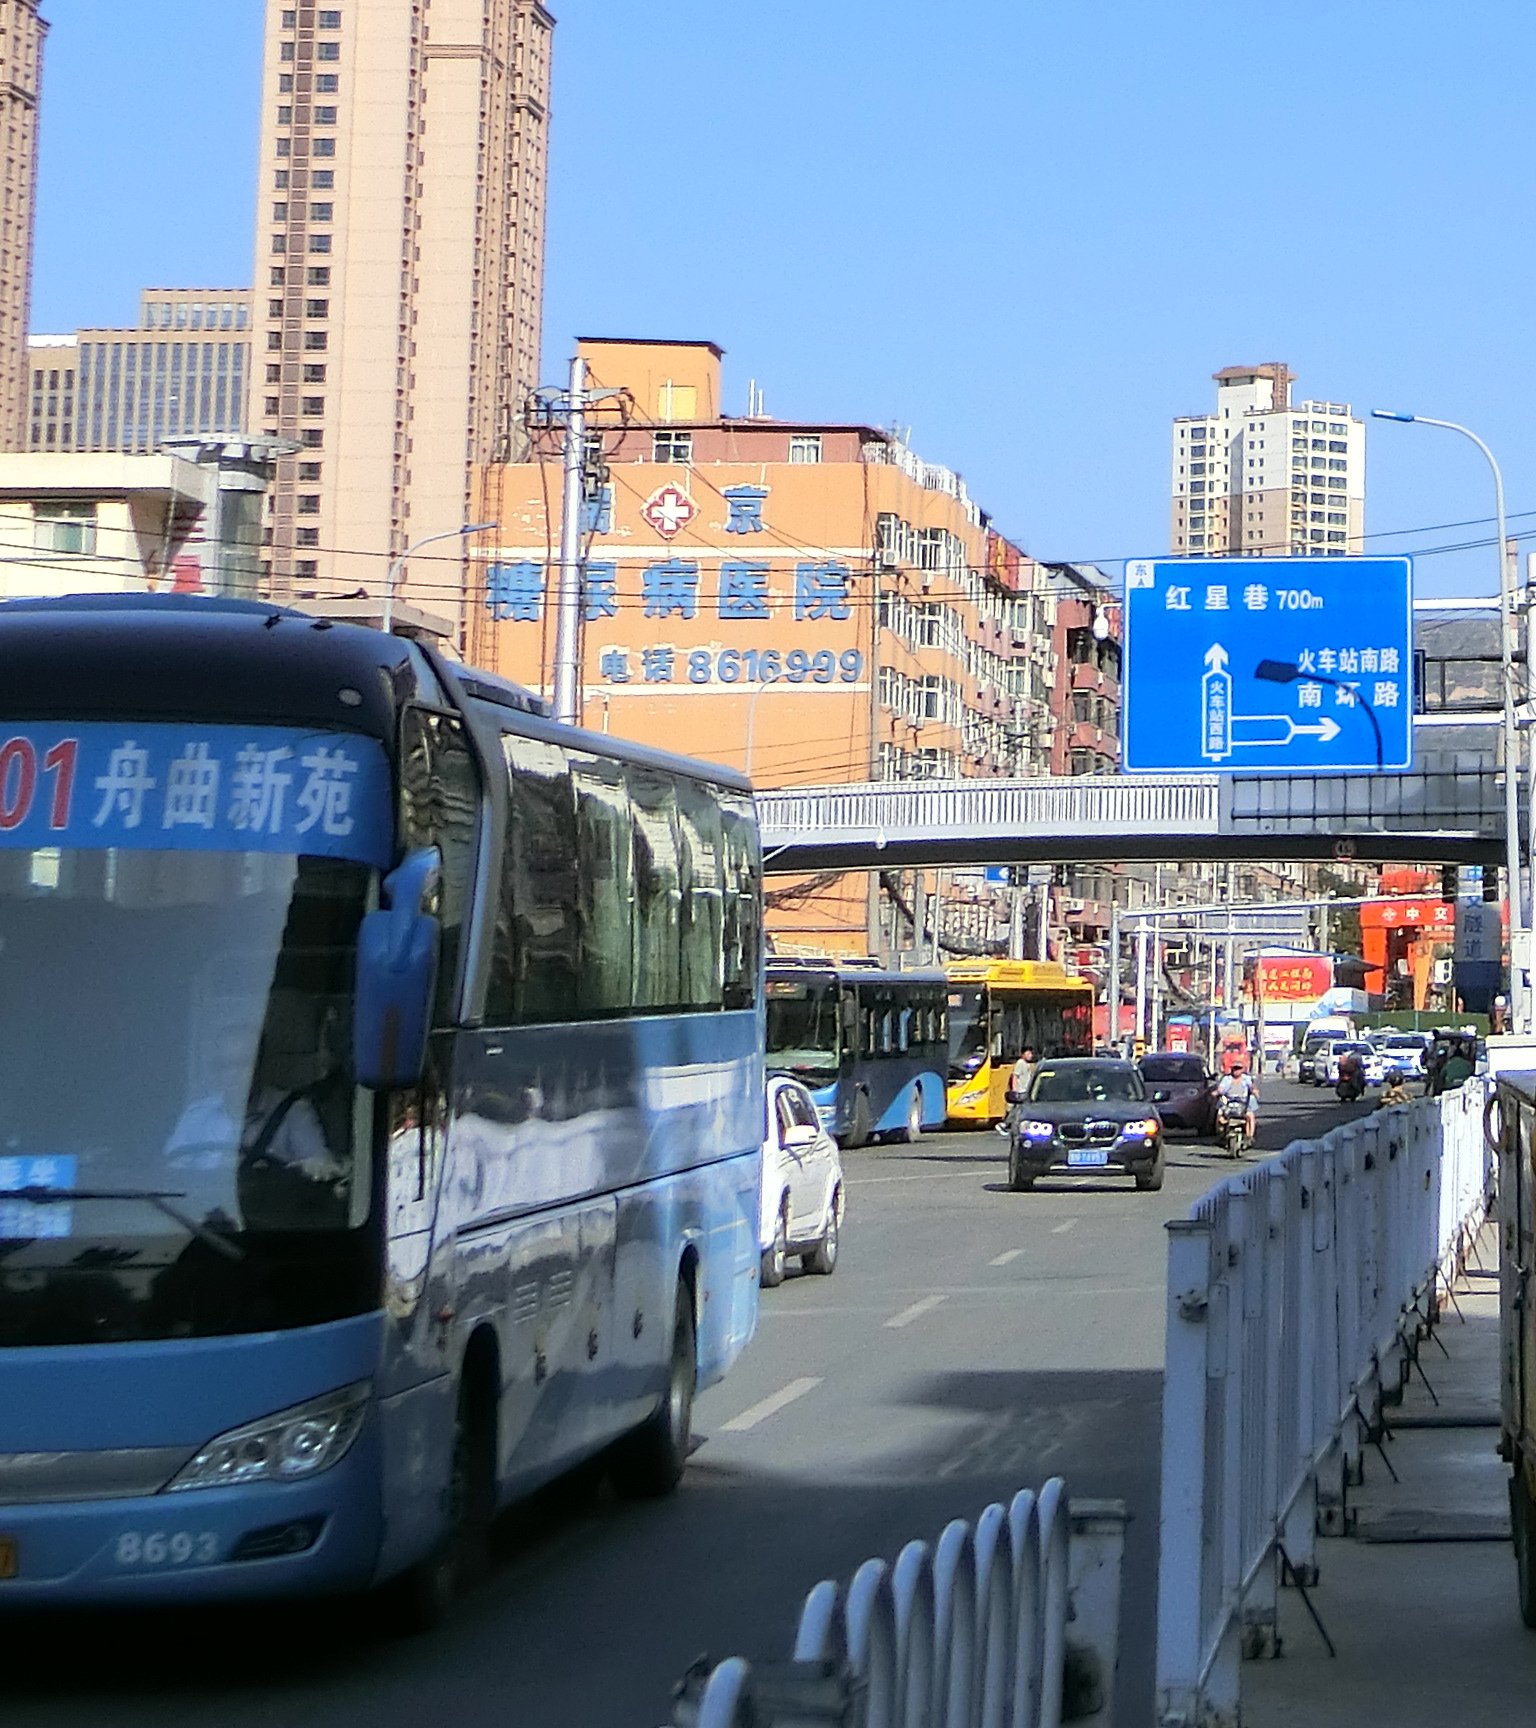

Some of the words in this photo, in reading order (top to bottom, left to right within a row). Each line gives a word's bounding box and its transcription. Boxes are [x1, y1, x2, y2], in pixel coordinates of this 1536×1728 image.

[486, 559, 853, 621] 糖尿病医院
[1165, 584, 1269, 611] 红星巷
[1276, 589, 1324, 610] 700m
[600, 648, 674, 683] 电话
[687, 647, 864, 684] 8616999
[1297, 647, 1399, 674] 火车站南路
[1296, 681, 1399, 709] 南环路
[1208, 680, 1225, 751] 火车站西路
[93, 737, 360, 838] 舟曲新苑
[114, 1530, 220, 1565] 8693
